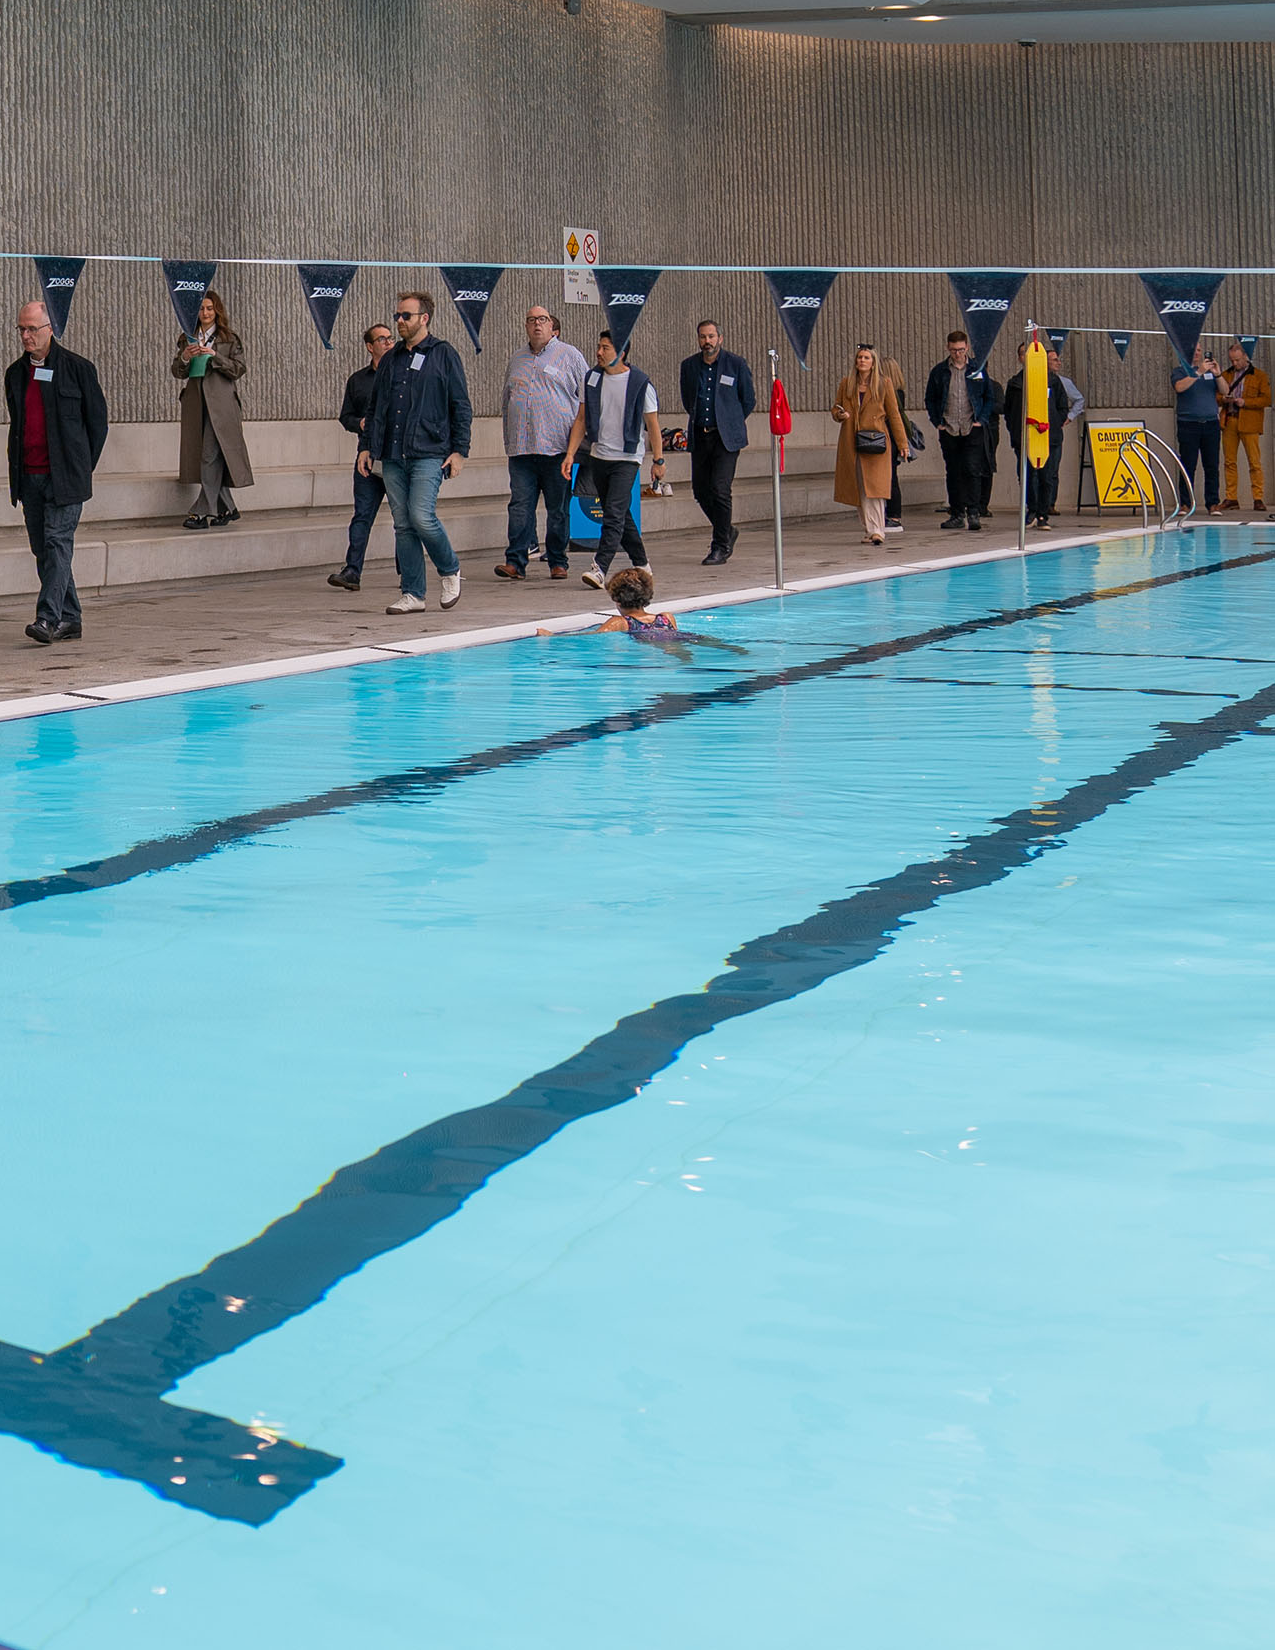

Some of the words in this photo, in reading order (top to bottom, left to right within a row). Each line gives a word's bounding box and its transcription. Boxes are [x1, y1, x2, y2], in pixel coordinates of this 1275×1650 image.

[45, 277, 75, 289] ZOGGS
[173, 281, 205, 292] ZOGGS
[309, 287, 343, 299] ZOGGS
[453, 291, 489, 302] ZOGGS
[608, 294, 645, 306] ZOGGS
[780, 296, 821, 309] ZOGGS
[965, 298, 1009, 312] ZOGGS
[1159, 300, 1206, 315] ZOGGS
